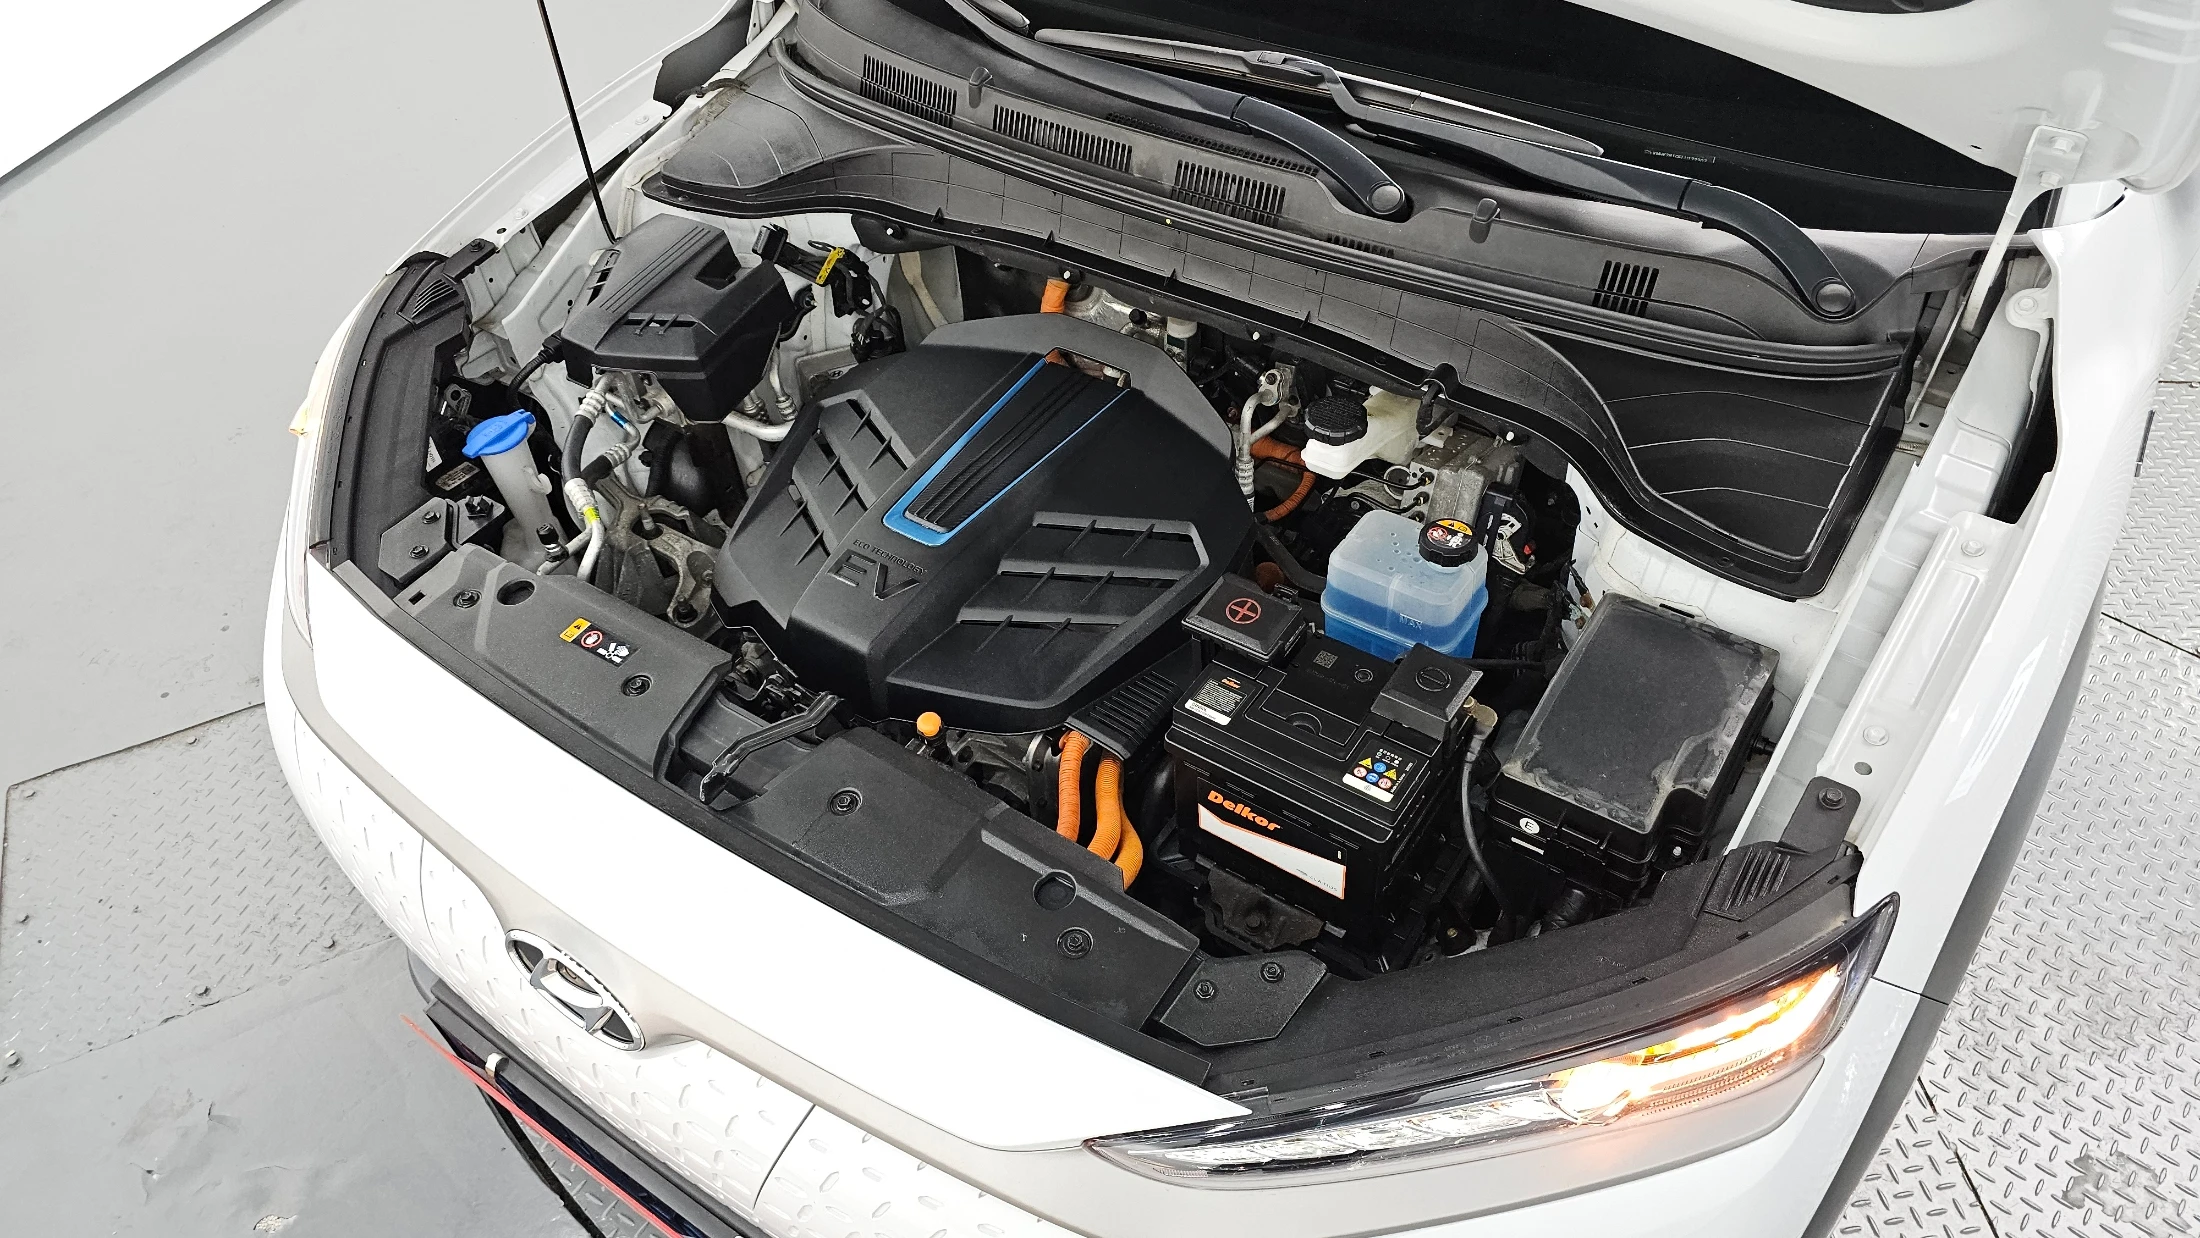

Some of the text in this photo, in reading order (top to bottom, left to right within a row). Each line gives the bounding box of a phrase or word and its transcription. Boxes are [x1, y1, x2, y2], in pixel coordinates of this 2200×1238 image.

[826, 549, 921, 602] EV
[853, 539, 928, 575] ECO TECHNOLOGY
[1399, 615, 1423, 631] MAX
[1207, 790, 1281, 831] Delkor
